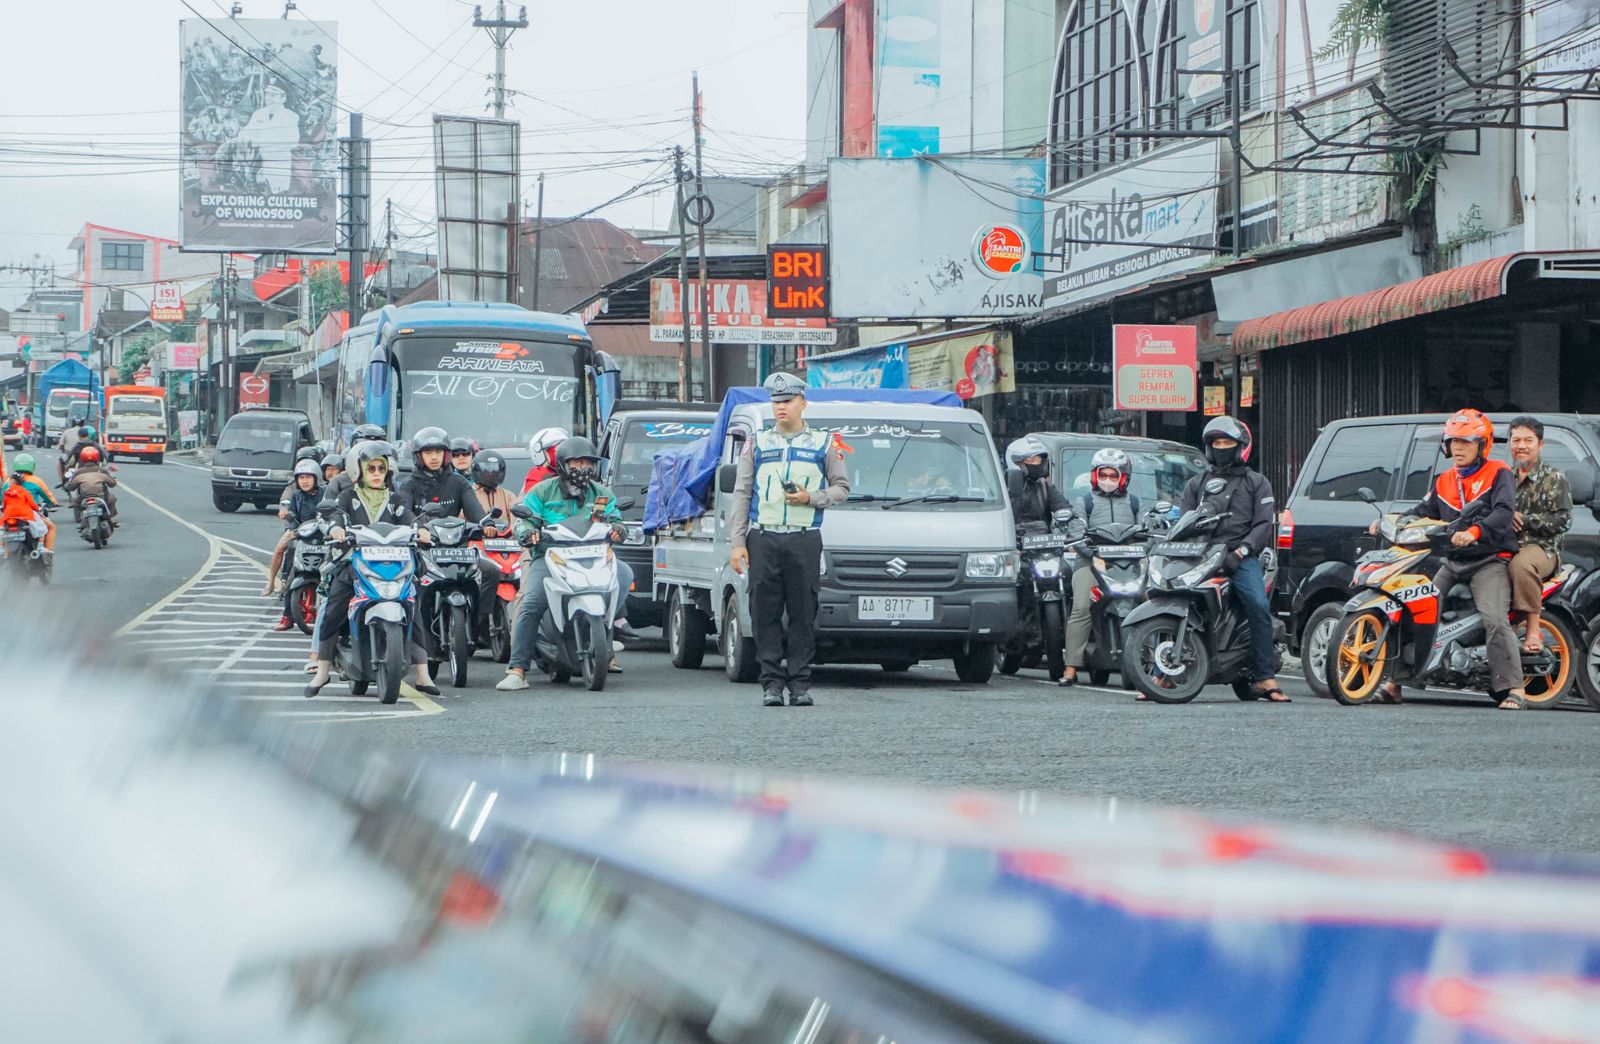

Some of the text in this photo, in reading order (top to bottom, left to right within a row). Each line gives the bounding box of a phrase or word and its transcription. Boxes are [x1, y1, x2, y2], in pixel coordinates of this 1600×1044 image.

[1555, 42, 1600, 66] Pangera
[200, 194, 318, 208] EXPLORING CULTURE
[215, 207, 303, 220] OF WONOSOBO
[1050, 187, 1144, 270] Ajisaka
[1145, 195, 1181, 235] mart
[991, 243, 1022, 253] SANTRI
[773, 252, 823, 278] BRI
[1056, 272, 1084, 293] BELANJA
[1085, 266, 1110, 285] MURAH
[1114, 256, 1148, 277] SEMOGA
[160, 288, 175, 298] ISI
[773, 286, 825, 309] LinK
[437, 356, 545, 373] PARIWISATA
[1140, 369, 1174, 379] GEPREK
[412, 375, 573, 406] All Of Me
[1138, 381, 1176, 392] REMPAH
[1128, 394, 1186, 405] SUPER GURIH
[861, 598, 931, 613] AA 8717 T
[1385, 583, 1438, 612] REPSOL
